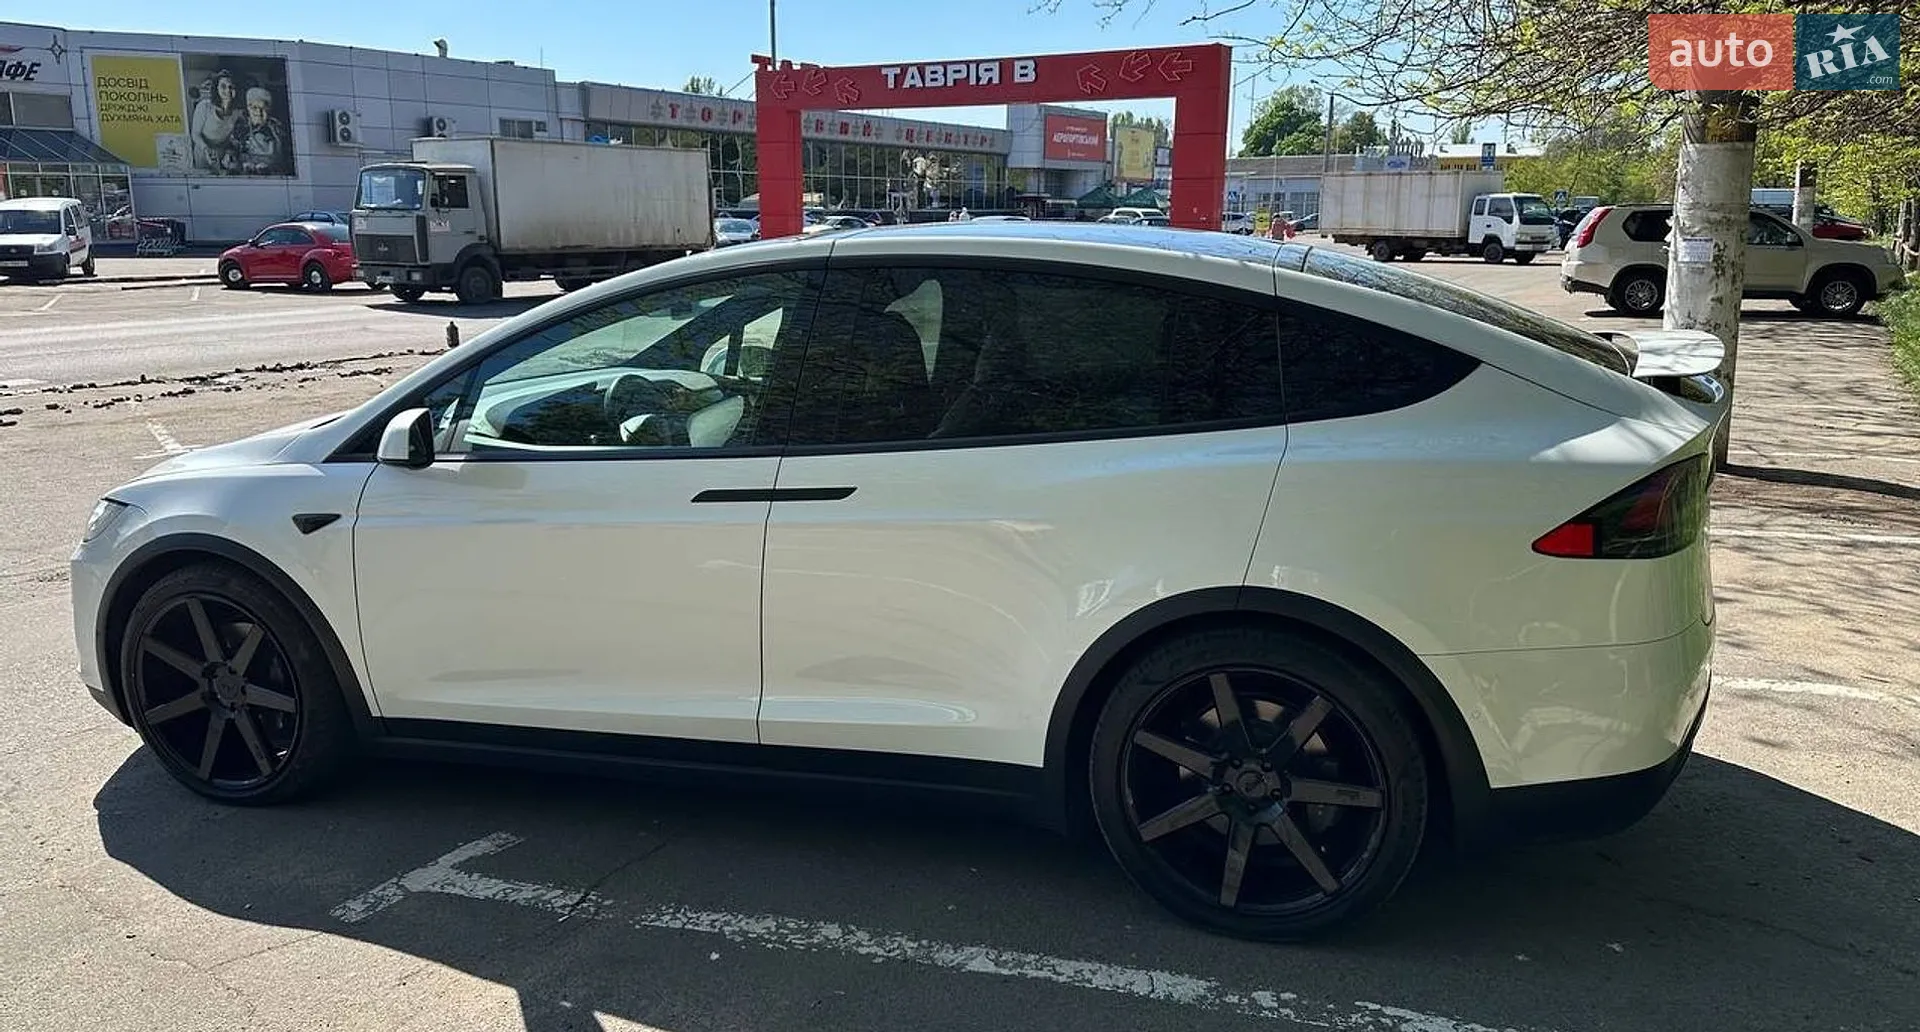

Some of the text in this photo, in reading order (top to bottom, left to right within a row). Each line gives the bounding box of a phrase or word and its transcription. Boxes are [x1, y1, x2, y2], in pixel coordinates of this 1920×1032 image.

[881, 59, 1036, 89] ТАВРІЯ В
[97, 76, 149, 90] ДОСВІД
[99, 90, 170, 103] ПОКОЛІНЬ
[101, 112, 181, 124] ДУХМЯНА ХАТА
